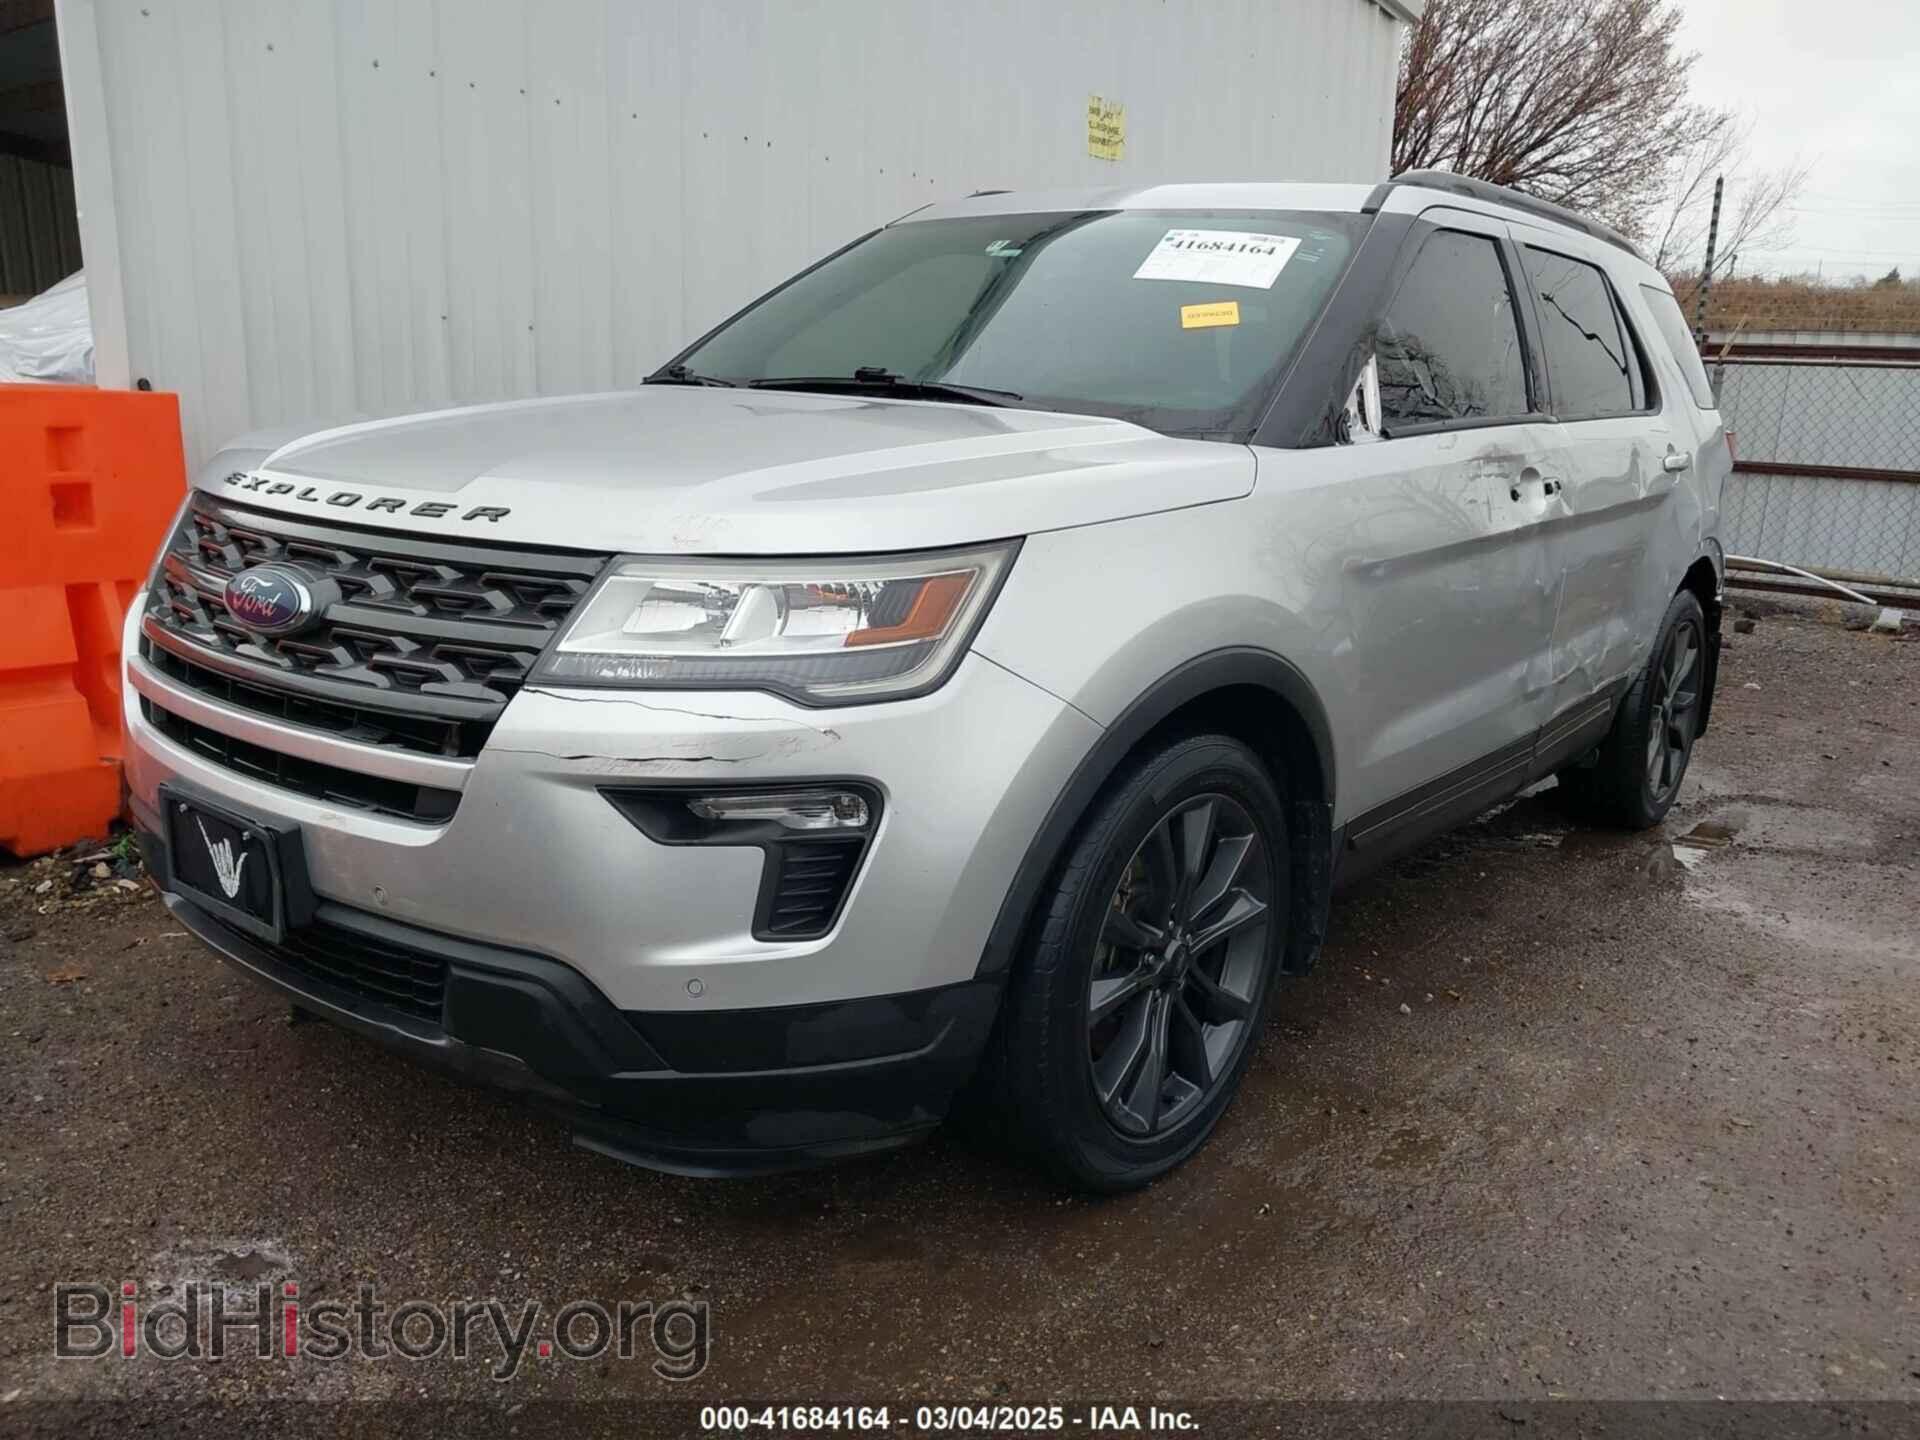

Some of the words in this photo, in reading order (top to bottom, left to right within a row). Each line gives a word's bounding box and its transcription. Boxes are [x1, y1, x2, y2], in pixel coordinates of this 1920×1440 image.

[1170, 239, 1277, 256] 41684164
[223, 471, 512, 523] EXPLORER
[233, 575, 283, 617] Ford
